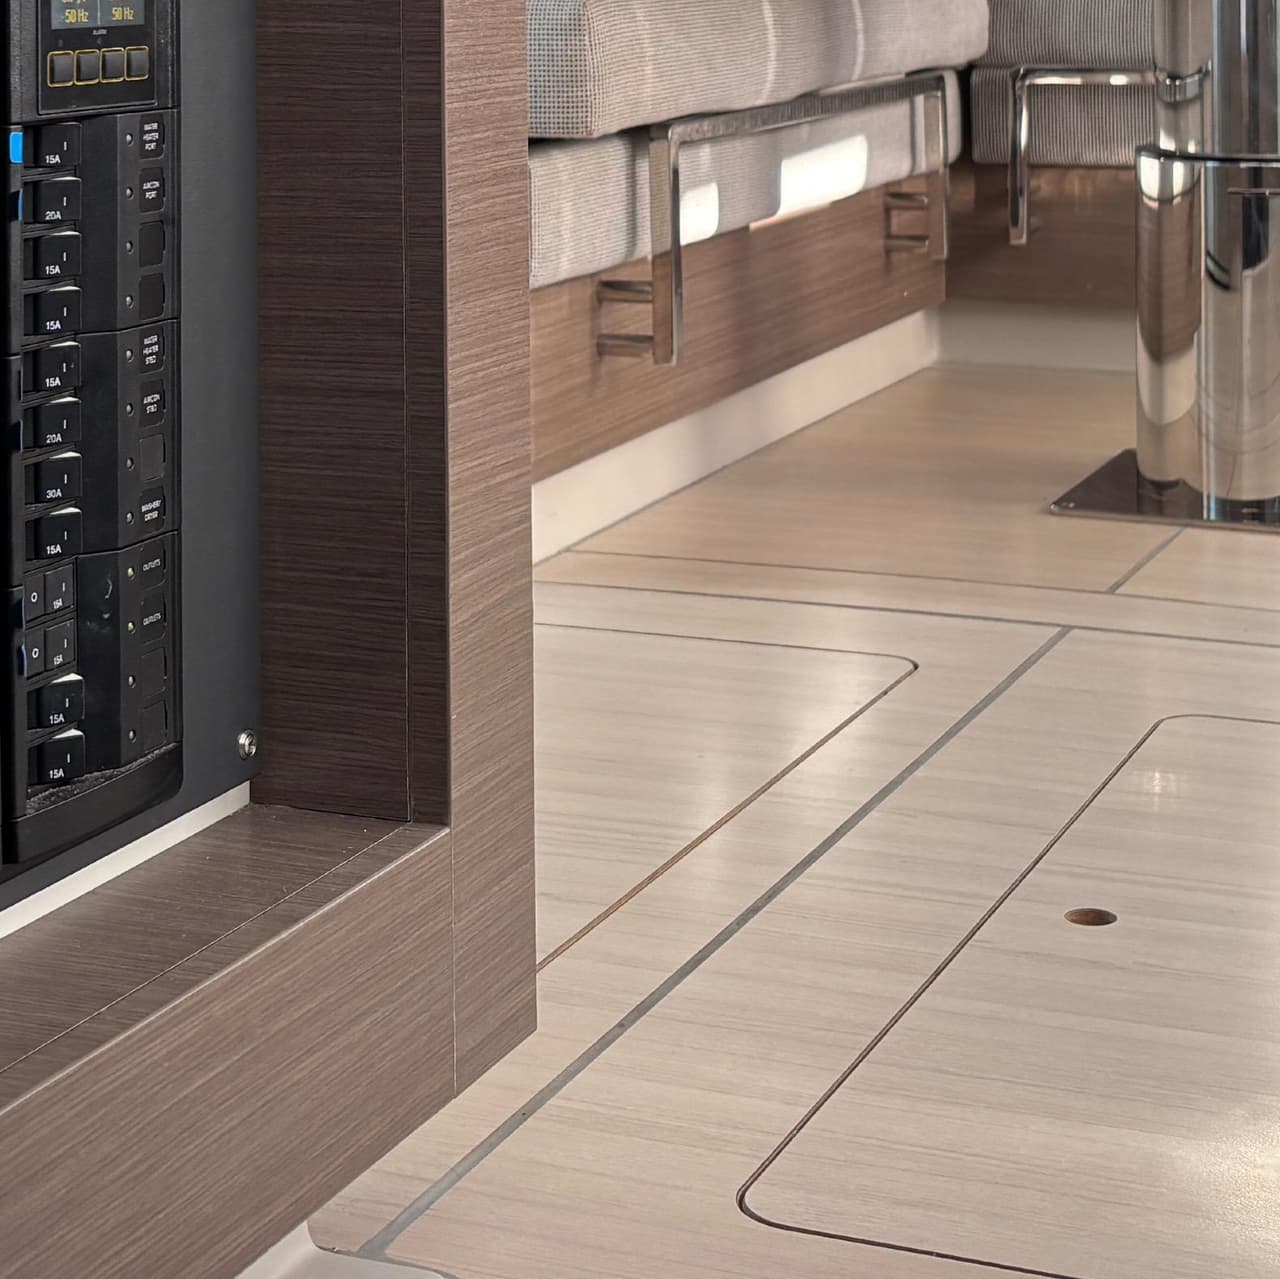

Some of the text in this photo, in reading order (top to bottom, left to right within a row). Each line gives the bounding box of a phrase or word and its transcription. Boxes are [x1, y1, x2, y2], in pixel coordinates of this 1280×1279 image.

[65, 8, 89, 23] 50 Hz
[111, 7, 134, 21] 50 Hz
[45, 154, 61, 164] 15A
[45, 211, 62, 220] 20A
[45, 265, 61, 275] 15A
[45, 321, 61, 331] 15A
[45, 377, 61, 387] 15A
[46, 433, 62, 443] 20A
[46, 488, 62, 498] 30A
[46, 544, 62, 555] 15A
[49, 714, 65, 725] 15A
[49, 769, 65, 779] 15A
